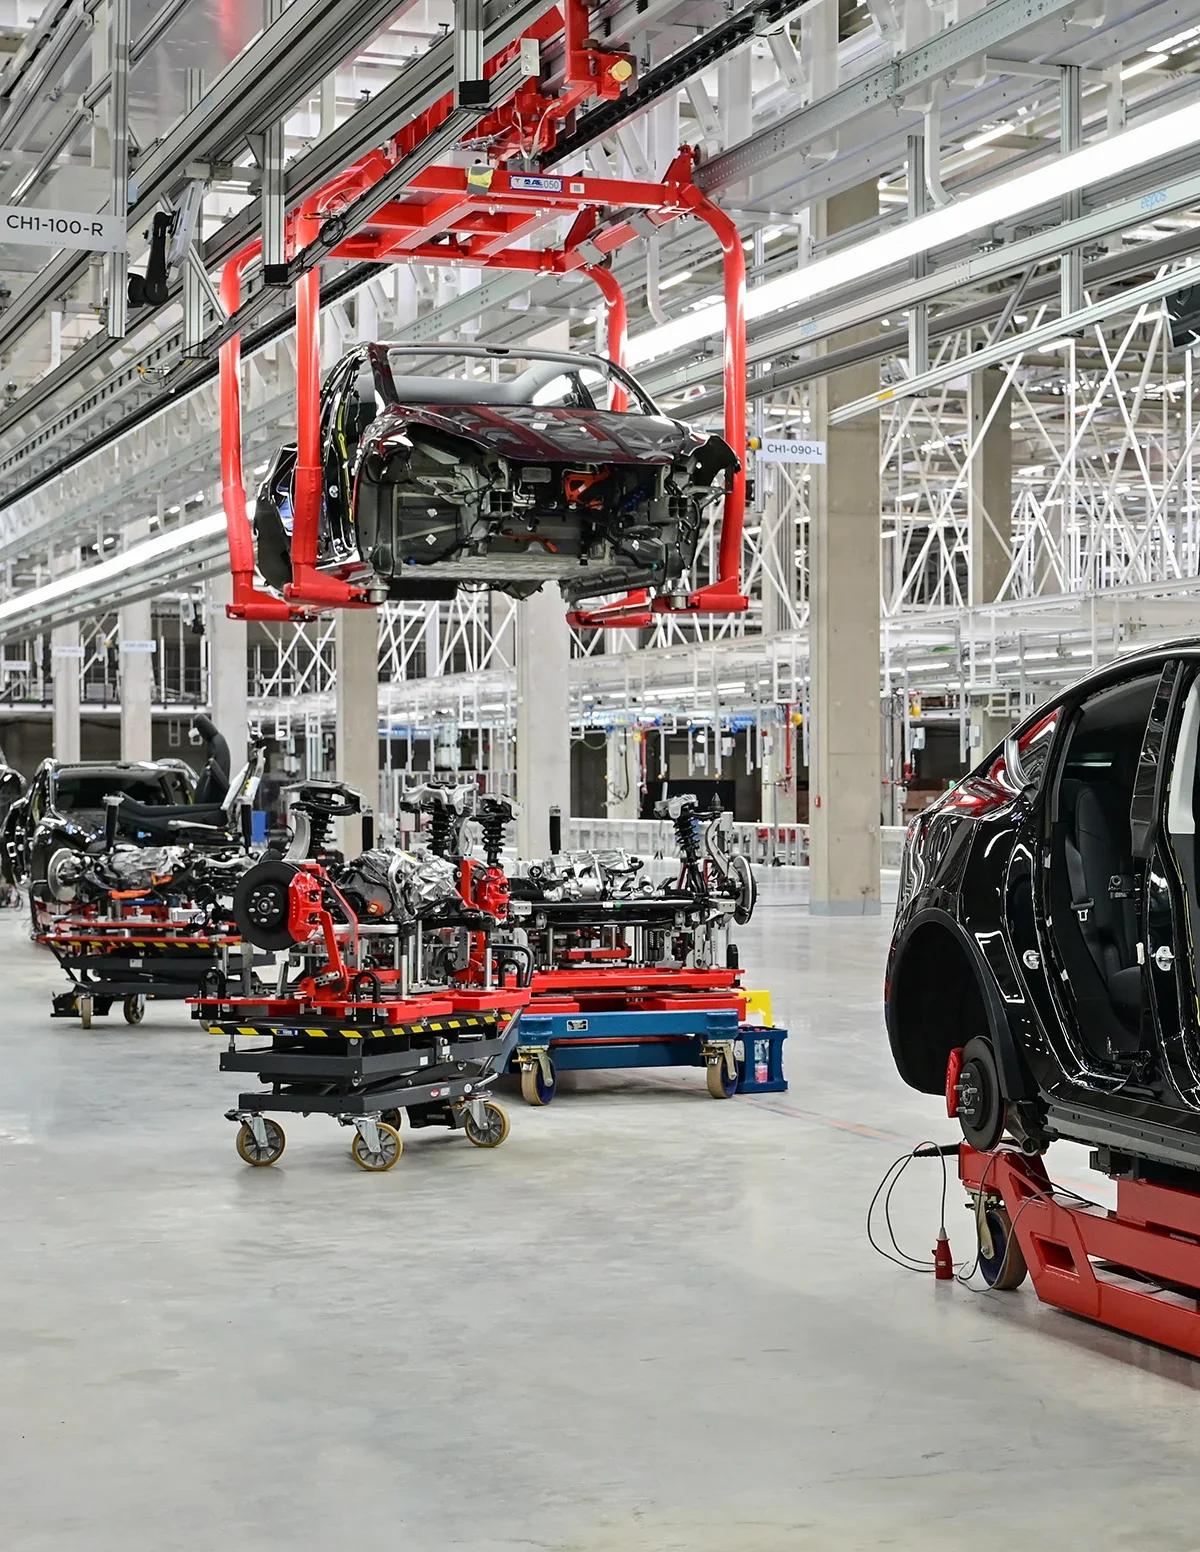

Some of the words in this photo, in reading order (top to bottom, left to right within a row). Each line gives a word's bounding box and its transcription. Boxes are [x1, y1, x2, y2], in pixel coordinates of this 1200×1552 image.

[543, 180, 559, 189] 050
[6, 214, 104, 237] CH1-100-R
[767, 444, 822, 455] CH1-090-L
